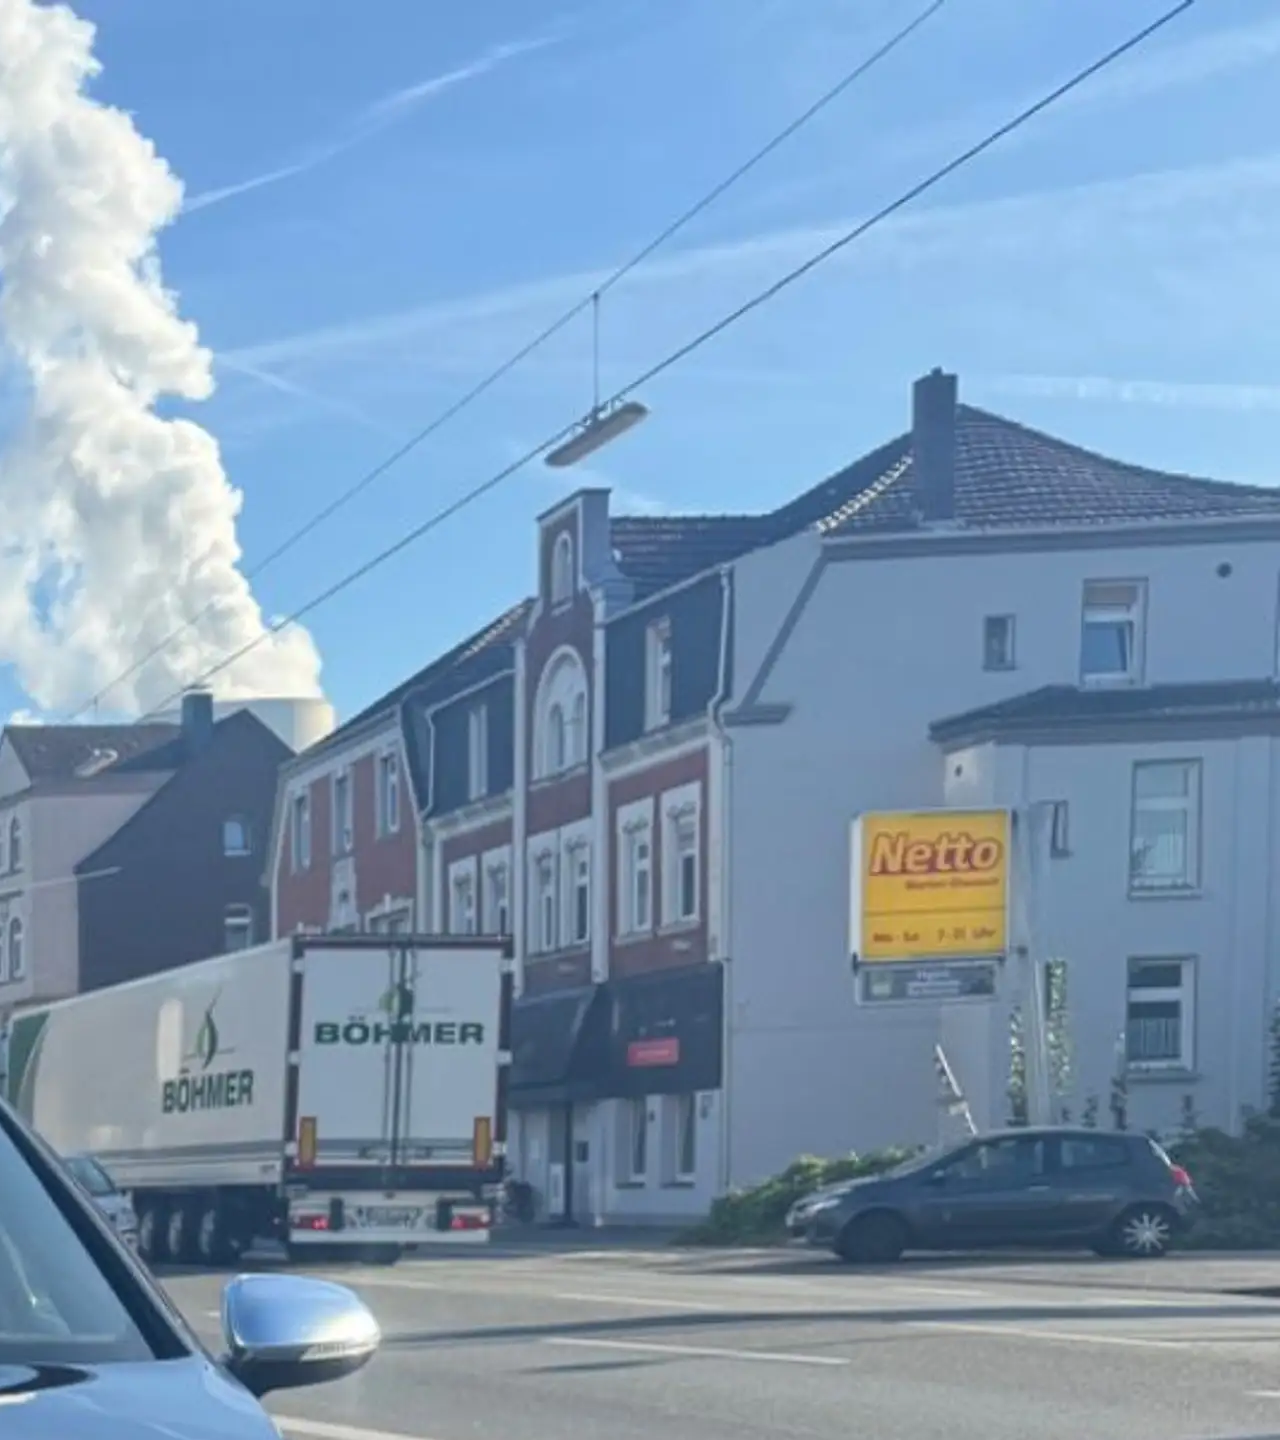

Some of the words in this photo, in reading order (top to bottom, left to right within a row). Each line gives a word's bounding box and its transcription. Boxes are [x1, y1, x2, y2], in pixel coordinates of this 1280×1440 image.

[870, 830, 1004, 876] Netto
[313, 1015, 486, 1044] BÖHMER
[162, 1066, 254, 1113] BÖHMER
